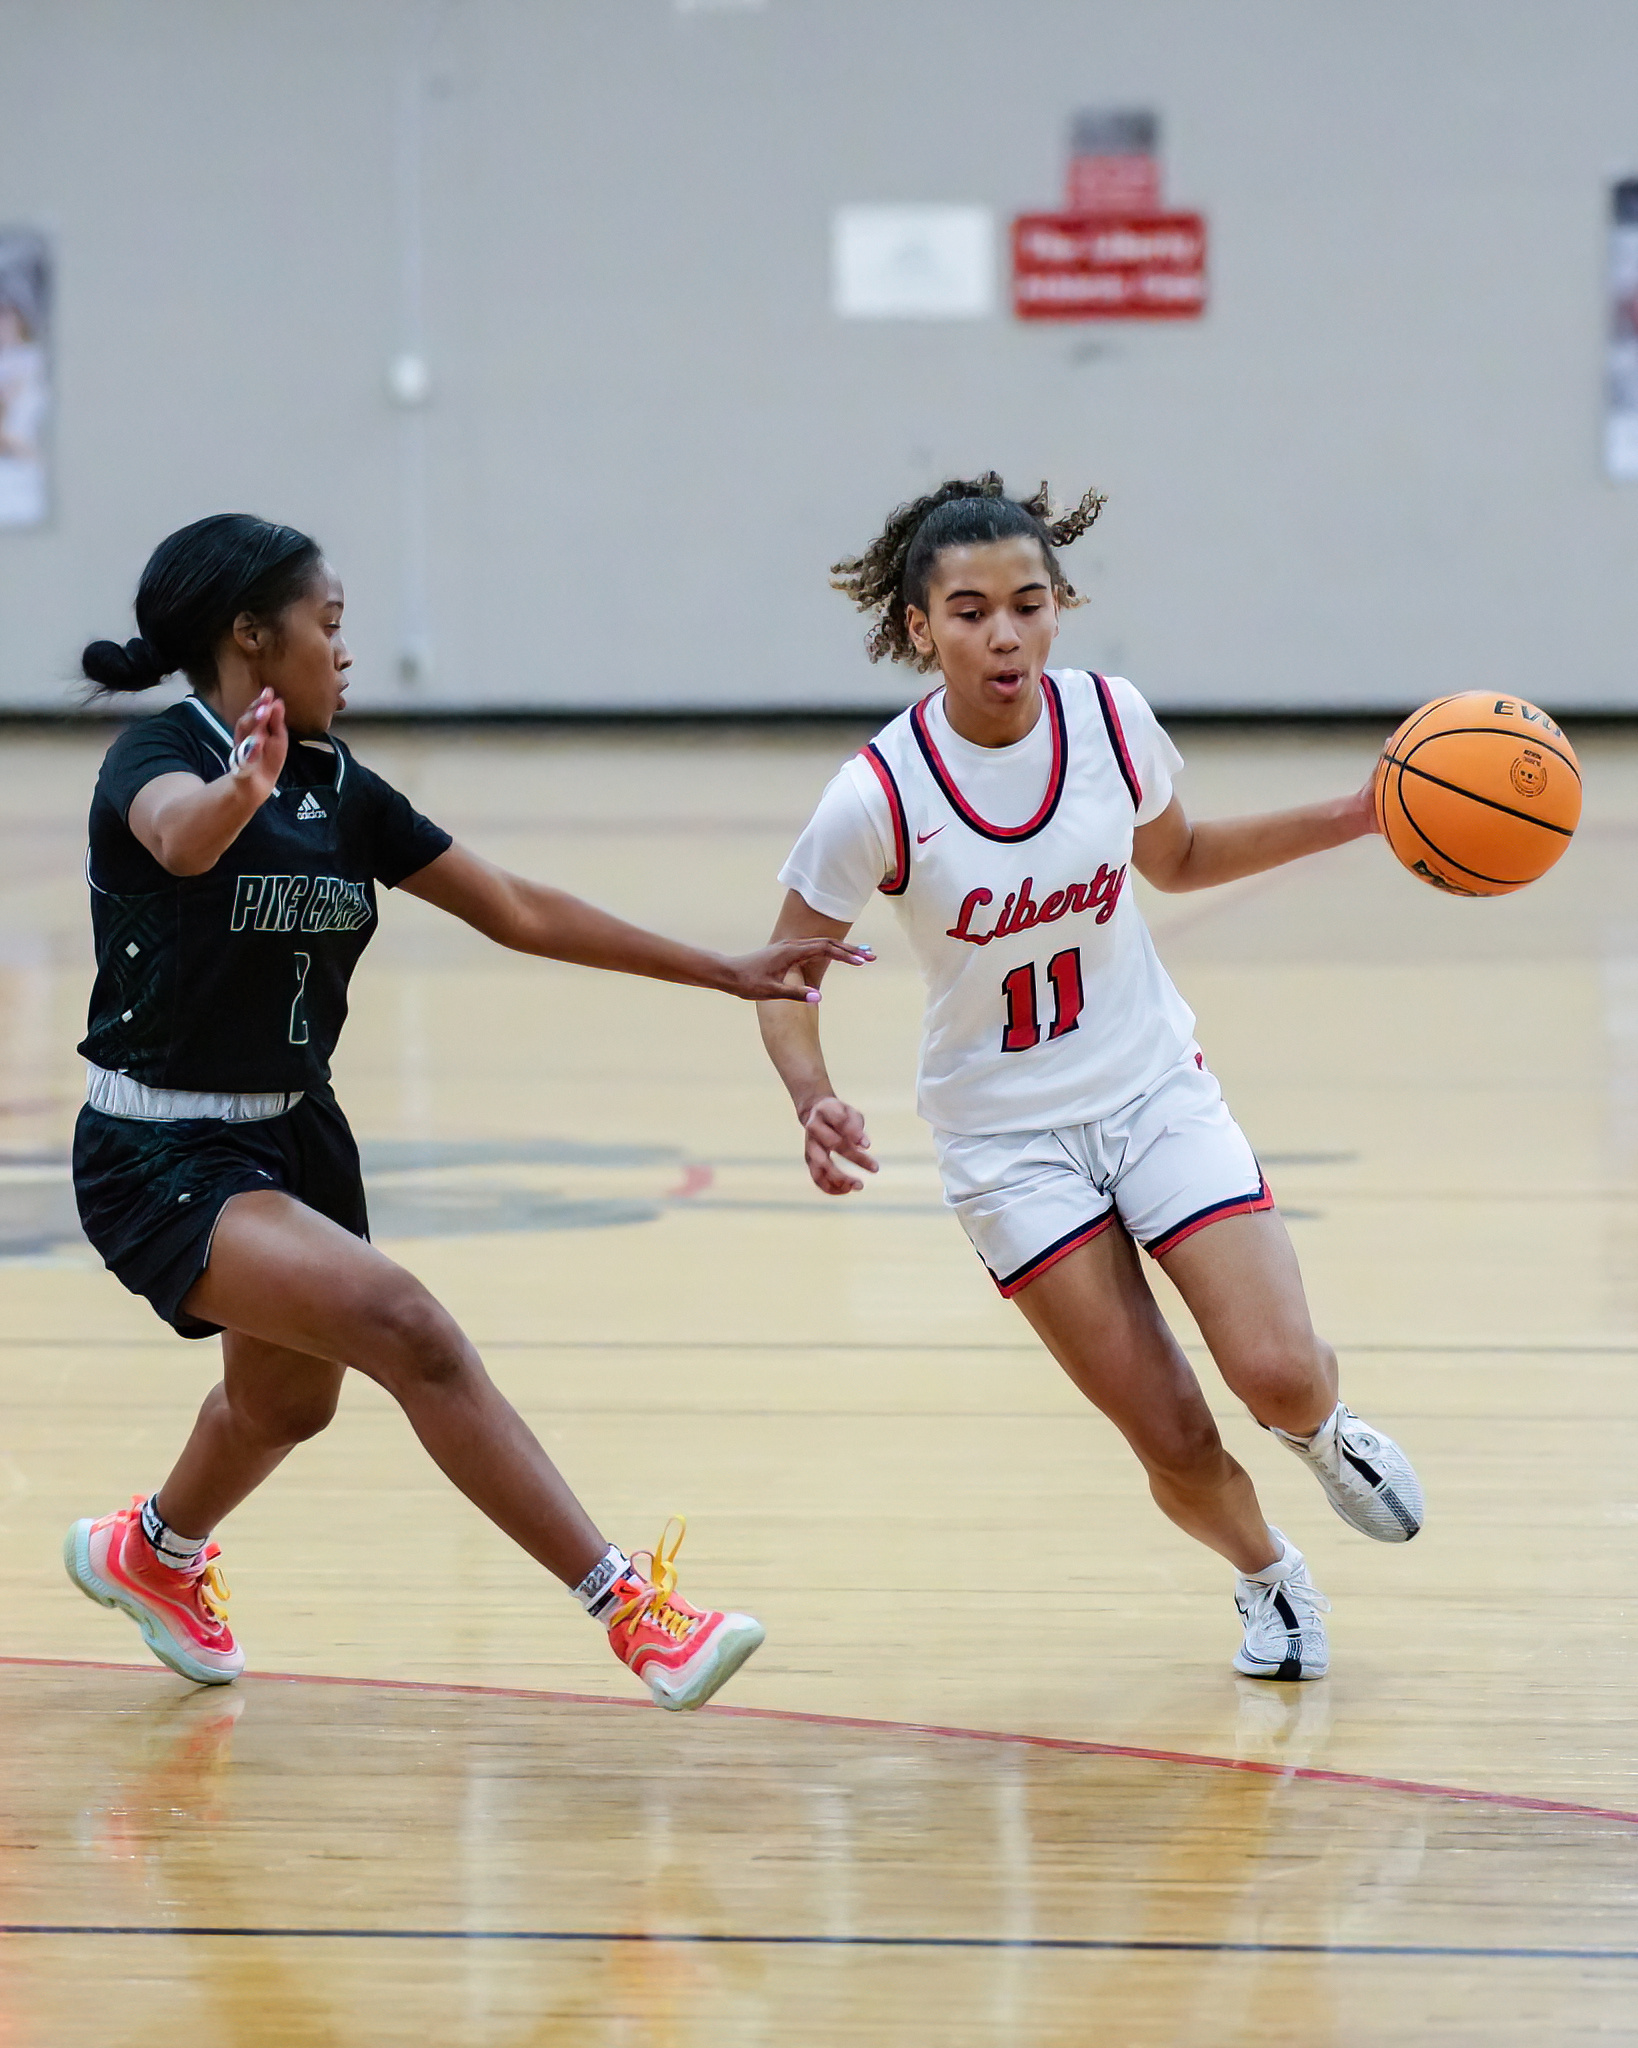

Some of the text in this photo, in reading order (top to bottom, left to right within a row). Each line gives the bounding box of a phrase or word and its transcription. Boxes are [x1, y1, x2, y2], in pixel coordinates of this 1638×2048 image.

[296, 810, 327, 820] adidas
[946, 863, 1126, 946] Liberty
[289, 951, 311, 1045] 2
[1000, 947, 1085, 1053] 11
